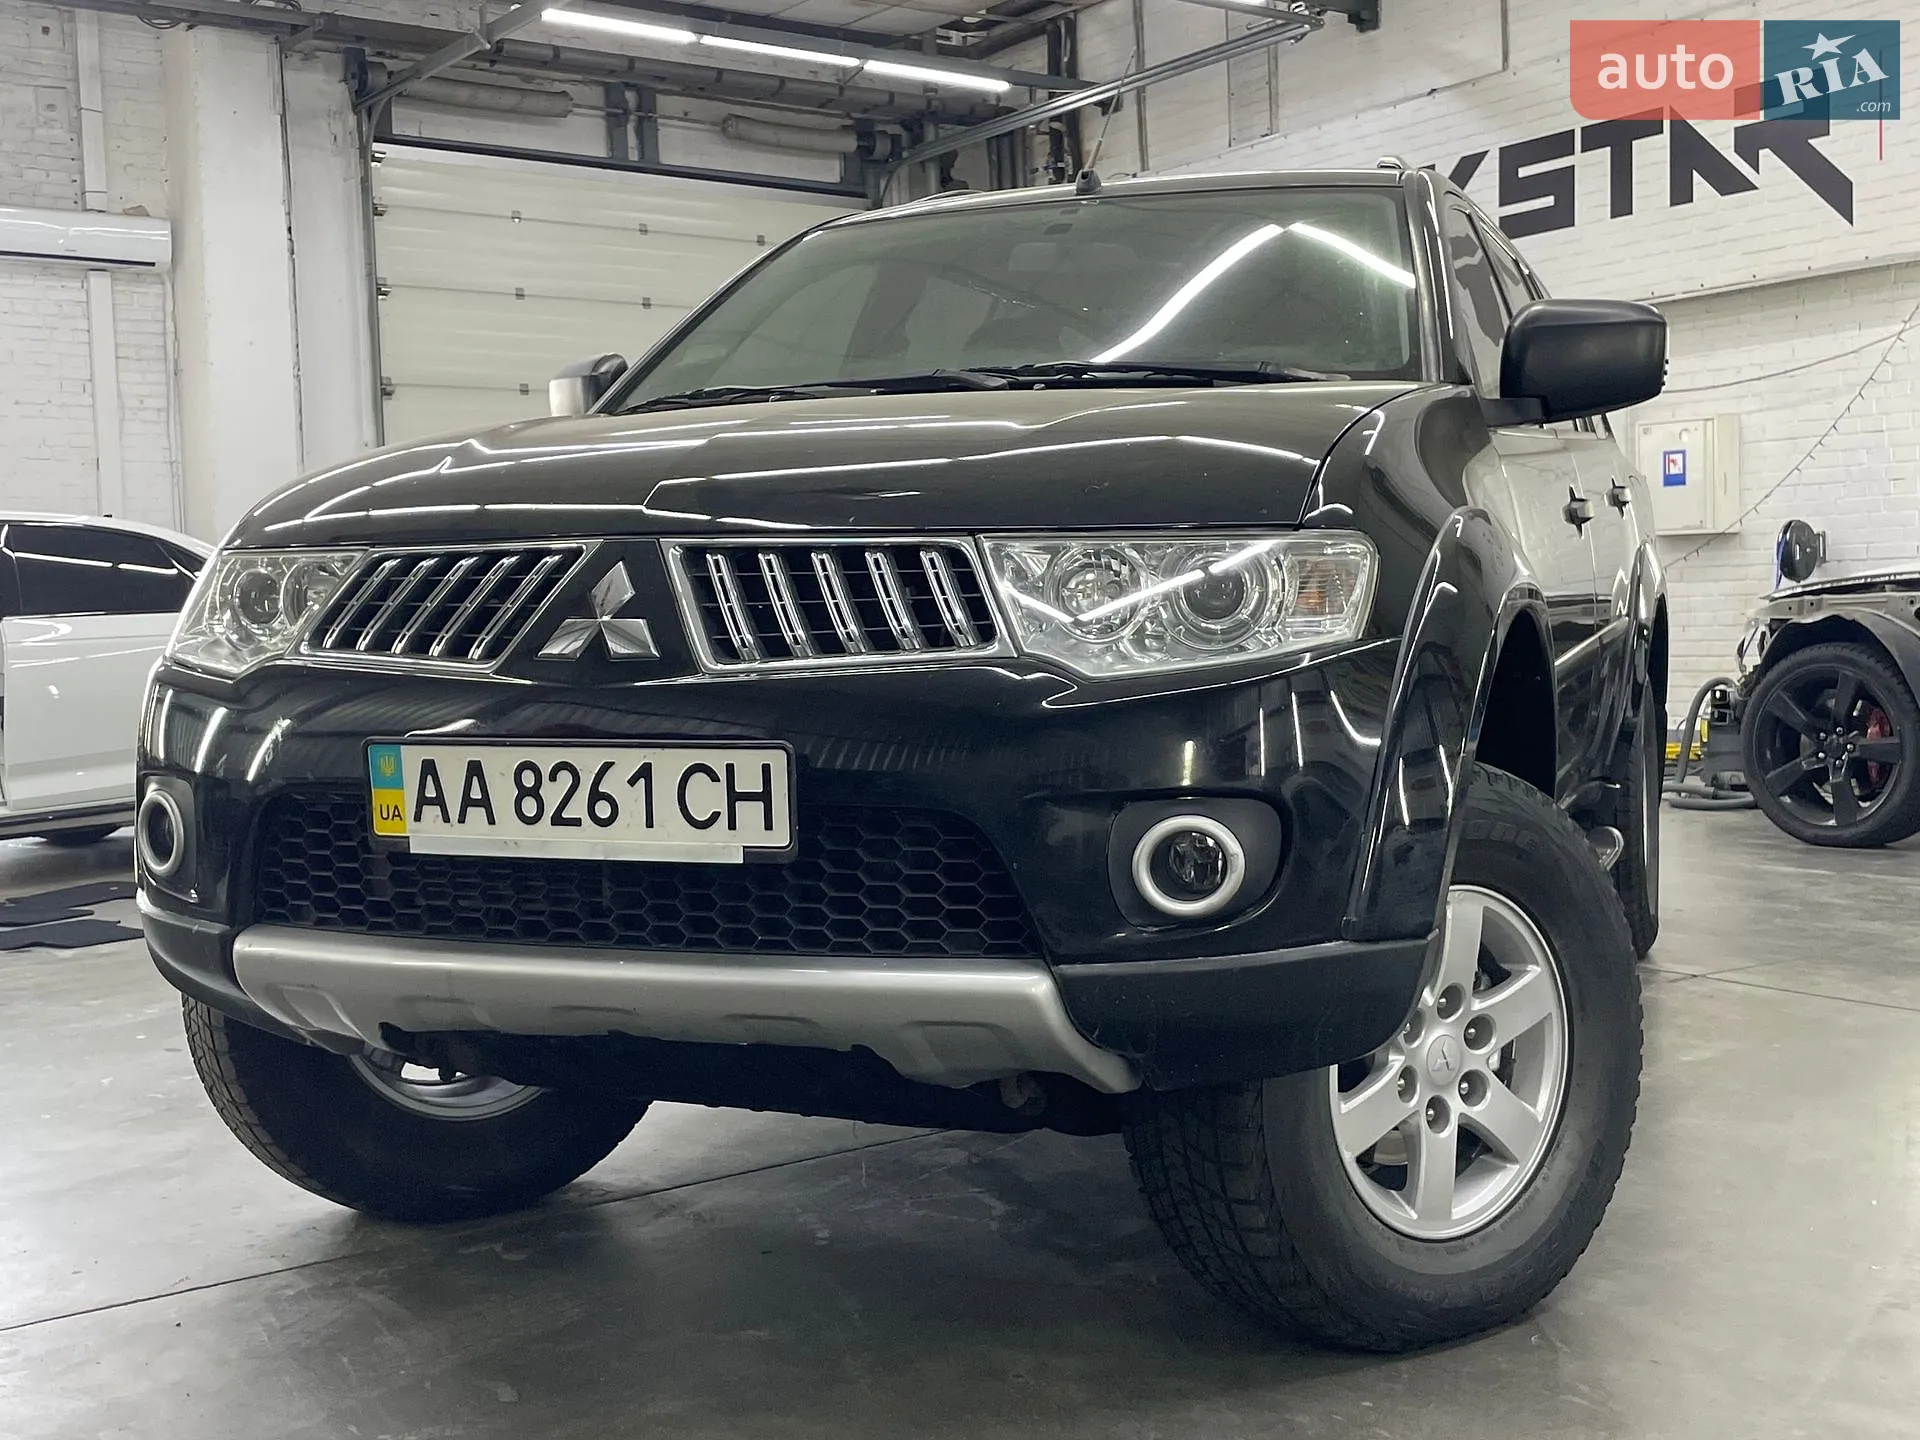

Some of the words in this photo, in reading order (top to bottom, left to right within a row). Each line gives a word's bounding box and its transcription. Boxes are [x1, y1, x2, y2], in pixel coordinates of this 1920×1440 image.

[1417, 67, 1854, 240] STAR
[379, 803, 404, 821] UA
[413, 758, 497, 826] AA
[513, 760, 655, 829] 8261
[676, 762, 774, 831] CH
